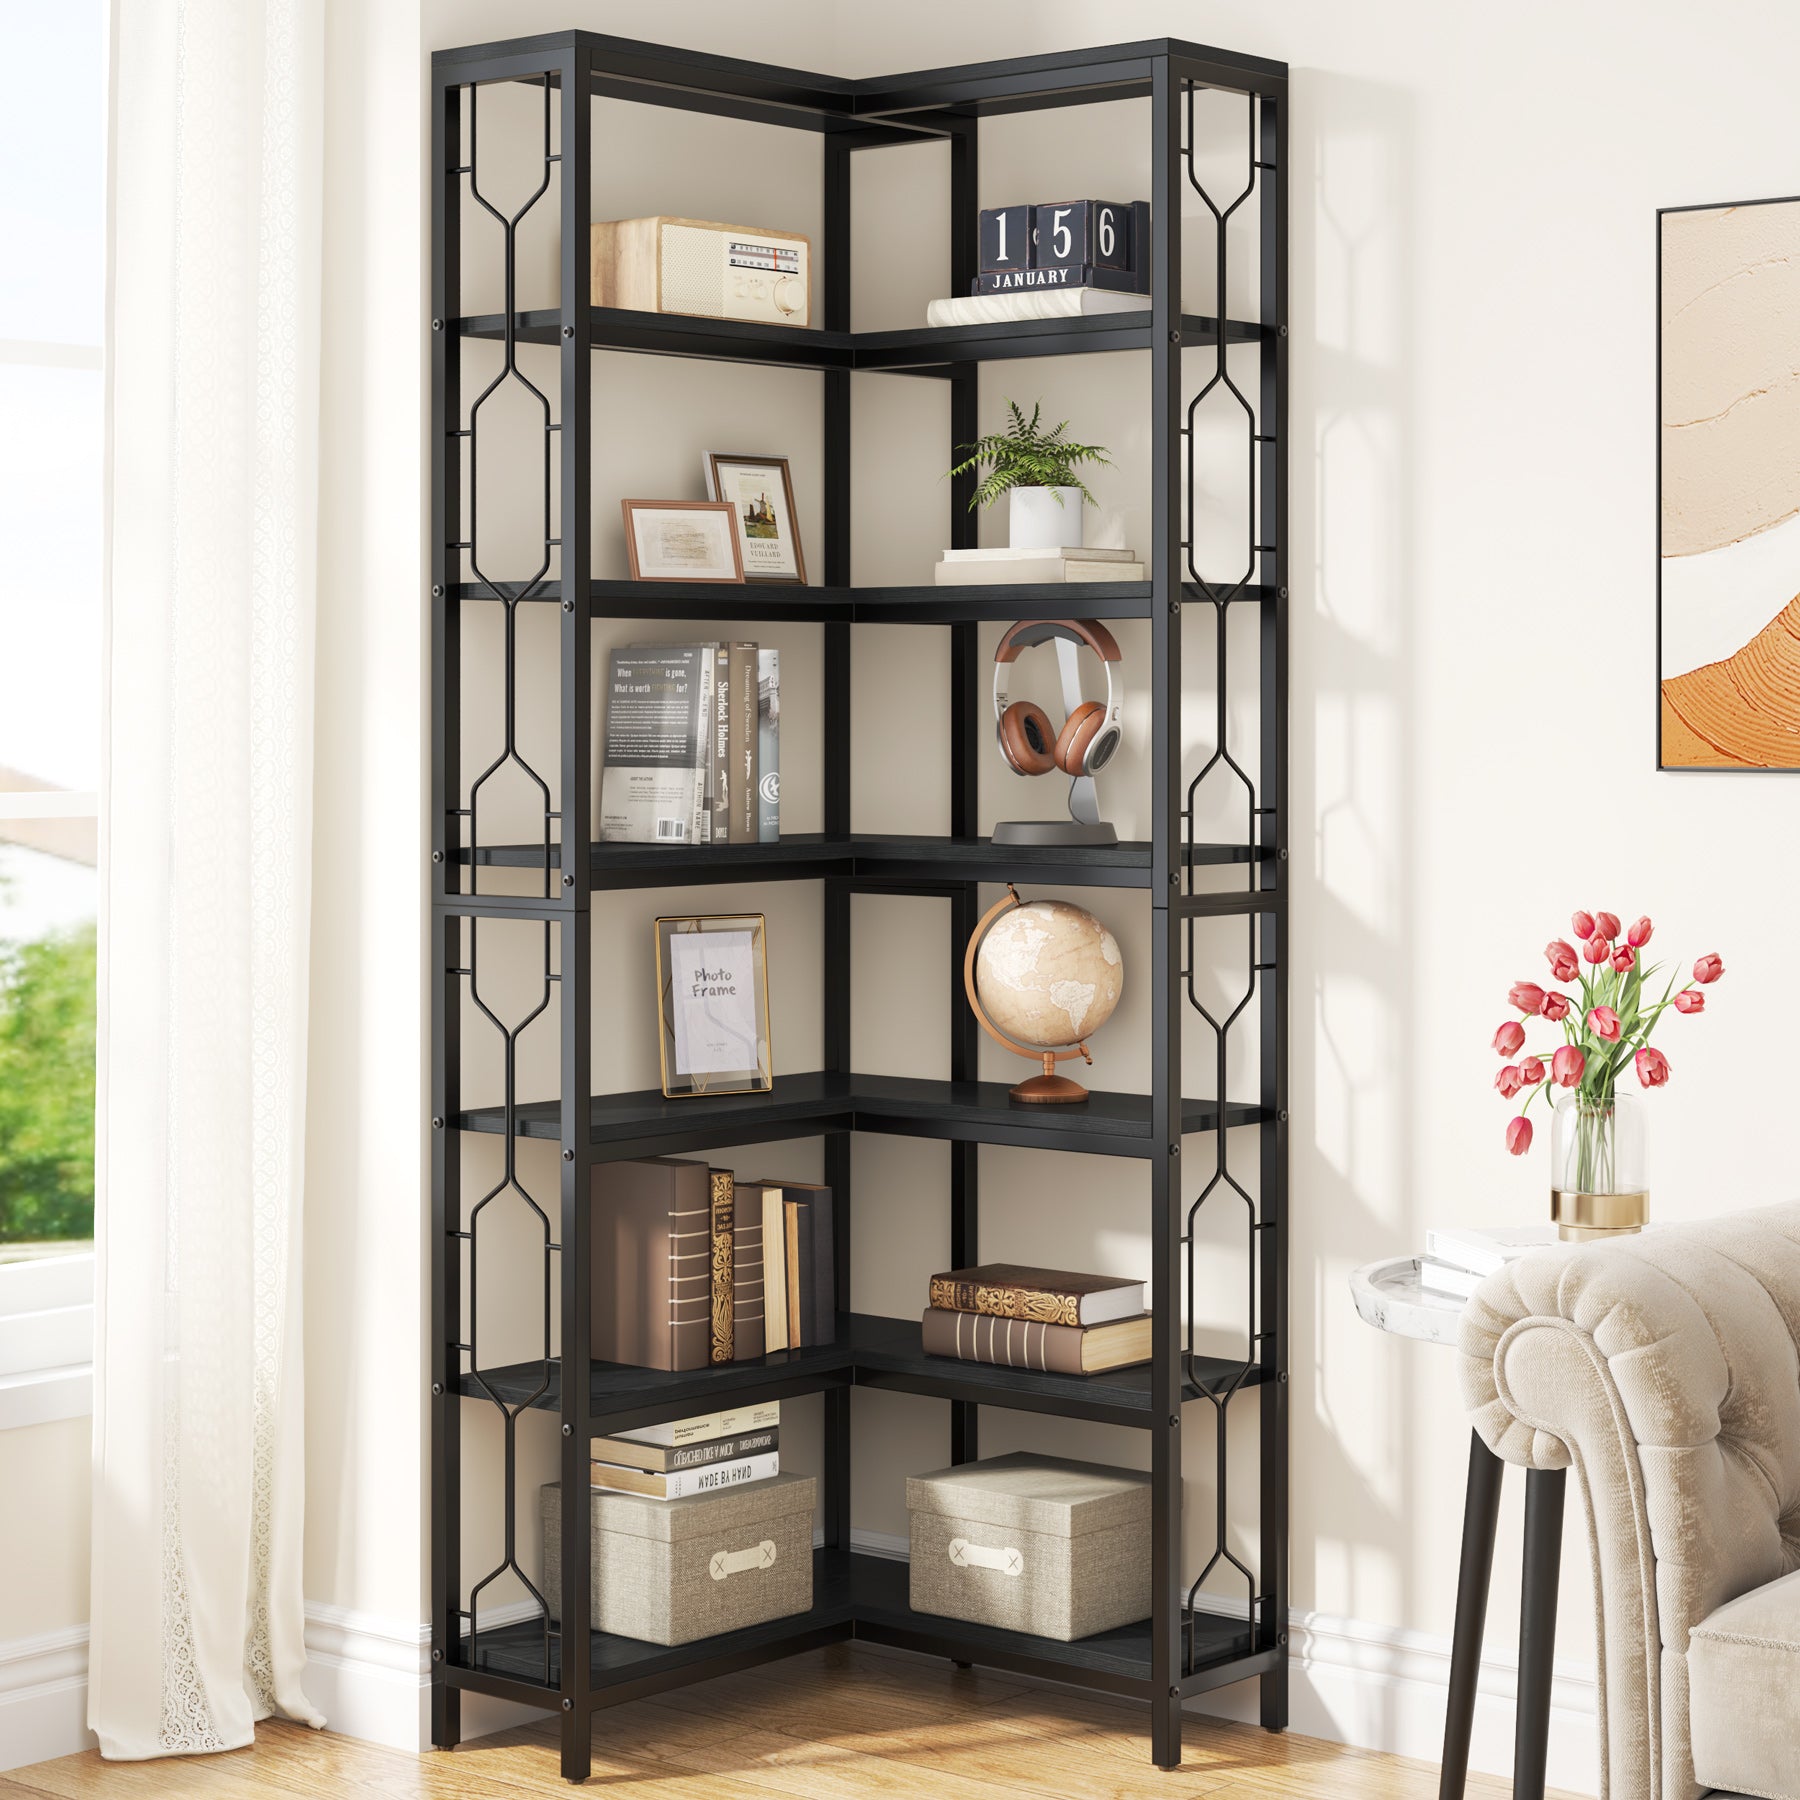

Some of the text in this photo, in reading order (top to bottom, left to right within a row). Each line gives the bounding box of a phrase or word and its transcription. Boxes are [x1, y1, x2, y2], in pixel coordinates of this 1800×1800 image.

[996, 207, 1115, 261] 1 5 6
[992, 269, 1069, 289] JANUARY
[617, 667, 632, 678] When
[665, 667, 670, 677] is
[614, 684, 628, 693] What
[629, 684, 634, 693] is
[635, 683, 651, 693] worth
[676, 683, 688, 693] for?
[744, 665, 752, 743] Dreaming of Sweden
[717, 681, 729, 758] Sherlock Holmes
[694, 967, 732, 983] Photo
[691, 983, 737, 997] Frame
